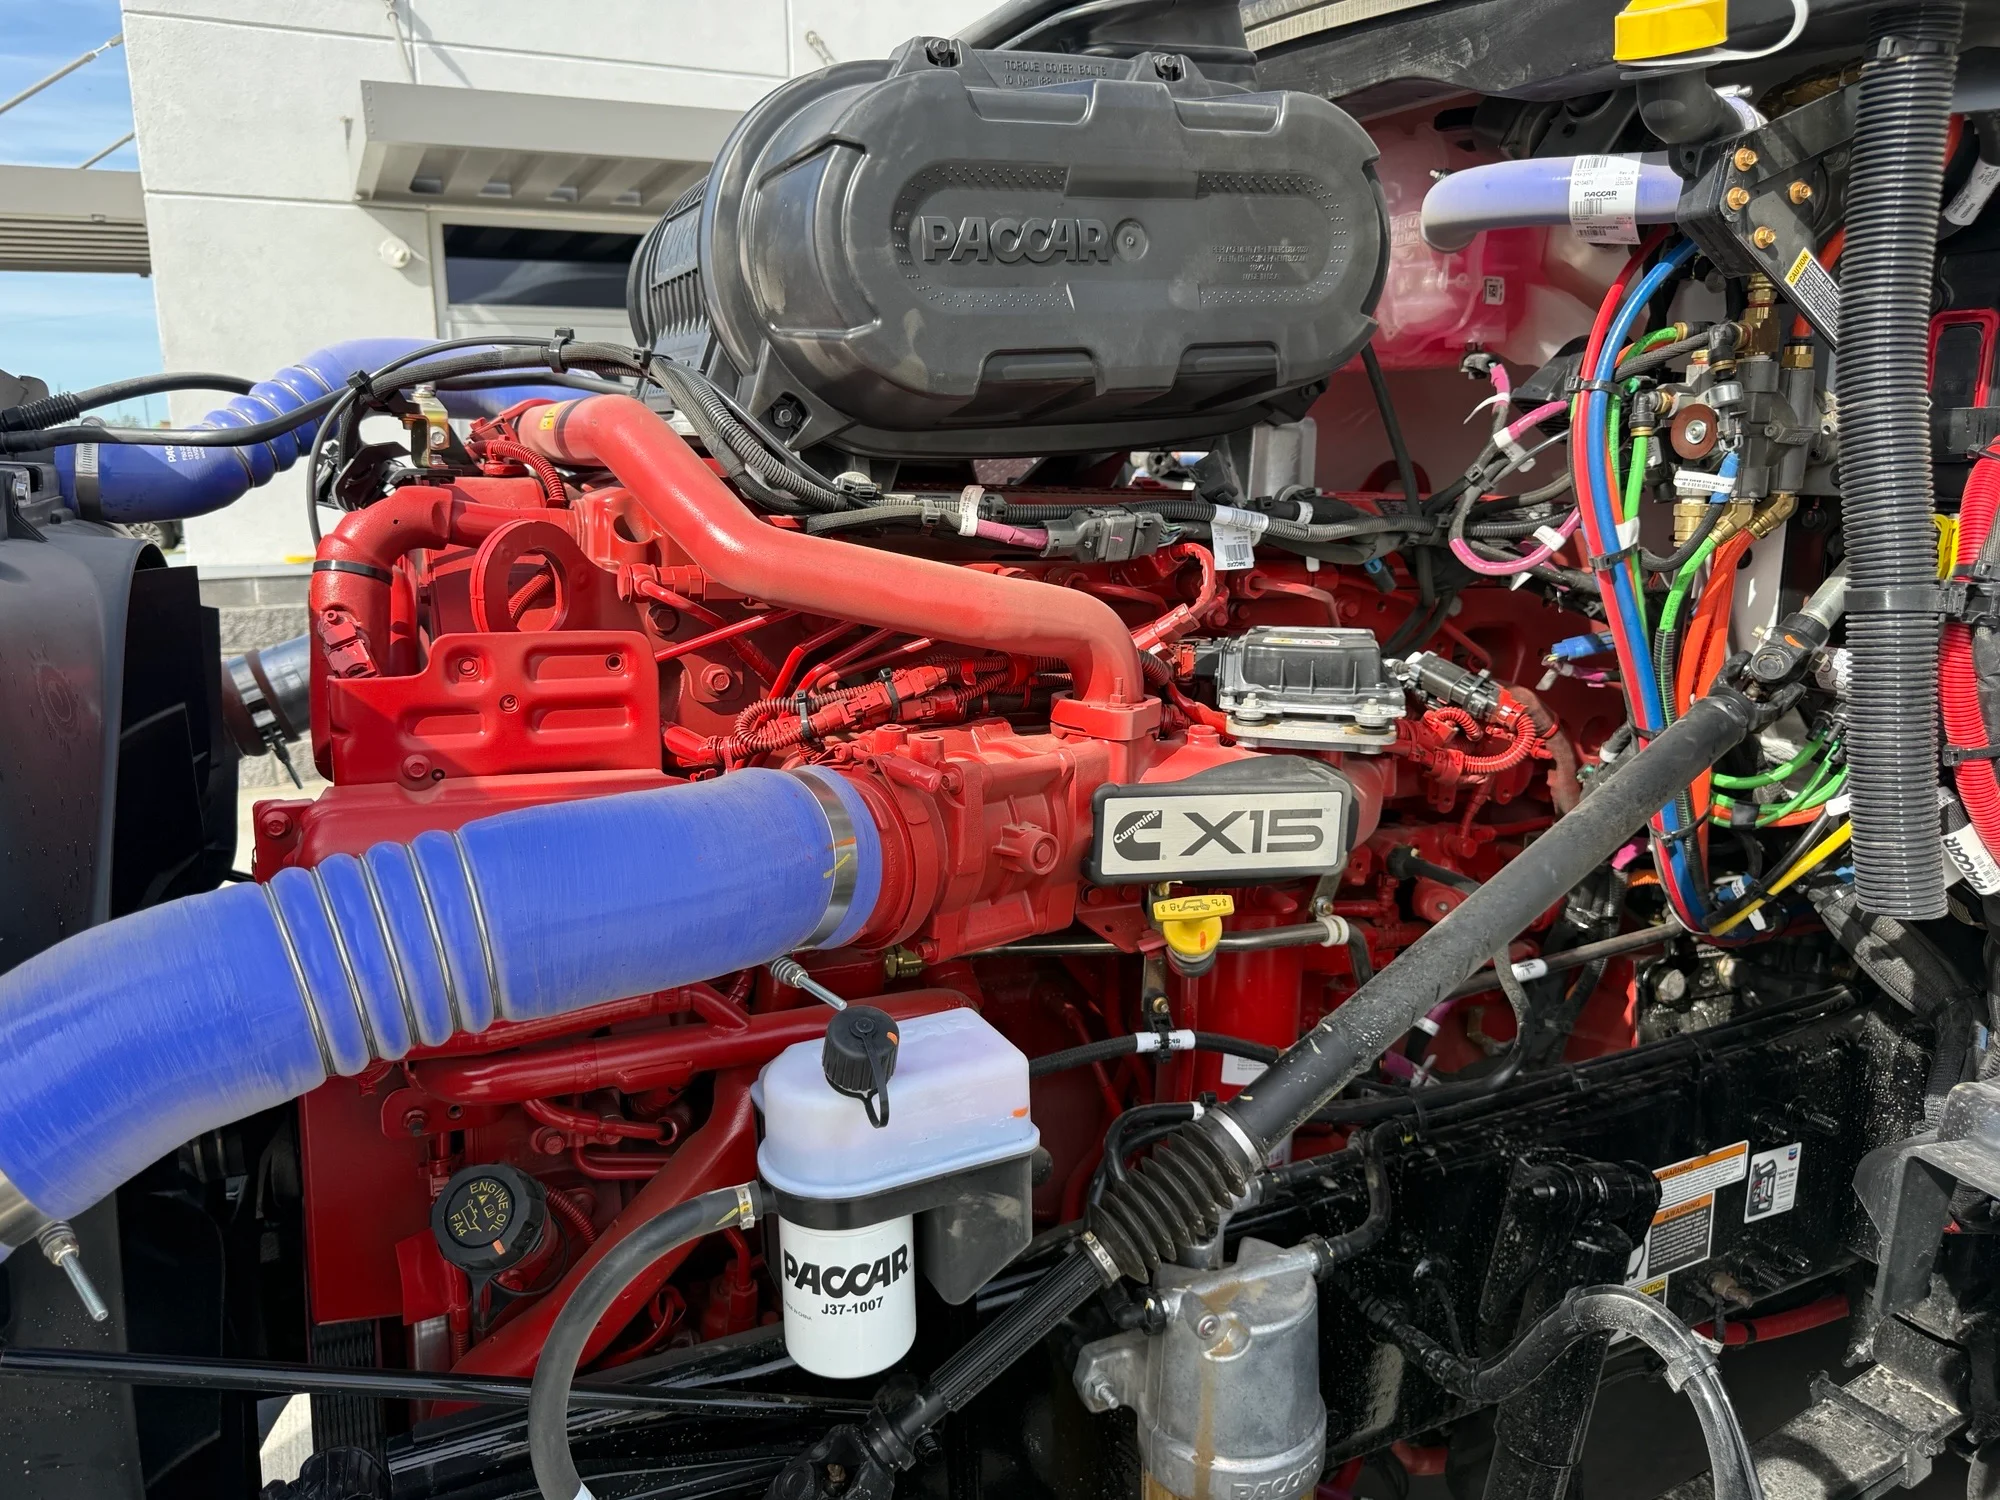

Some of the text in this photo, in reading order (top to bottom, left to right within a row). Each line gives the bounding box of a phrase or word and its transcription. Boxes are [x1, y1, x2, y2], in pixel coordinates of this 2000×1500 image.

[1004, 60, 1107, 77] TORQUE COVER BOLTS
[921, 216, 1109, 263] PACCAR
[1788, 254, 1809, 283] CAUTION
[1808, 260, 1826, 282] Extended
[165, 445, 177, 463] PAC
[1113, 809, 1160, 844] Cummins
[1178, 808, 1324, 857] X15
[1943, 836, 1988, 890] PACCAR
[1662, 1163, 1694, 1177] WARNING
[469, 1181, 509, 1232] ENGINE OIL
[1670, 1200, 1700, 1216] WARNING
[450, 1212, 468, 1237] FA4
[784, 1243, 908, 1298] PACCAR
[1640, 1280, 1665, 1293] AUTION
[821, 1296, 884, 1315] J37-1007
[1230, 1456, 1320, 1500] PACCAR
